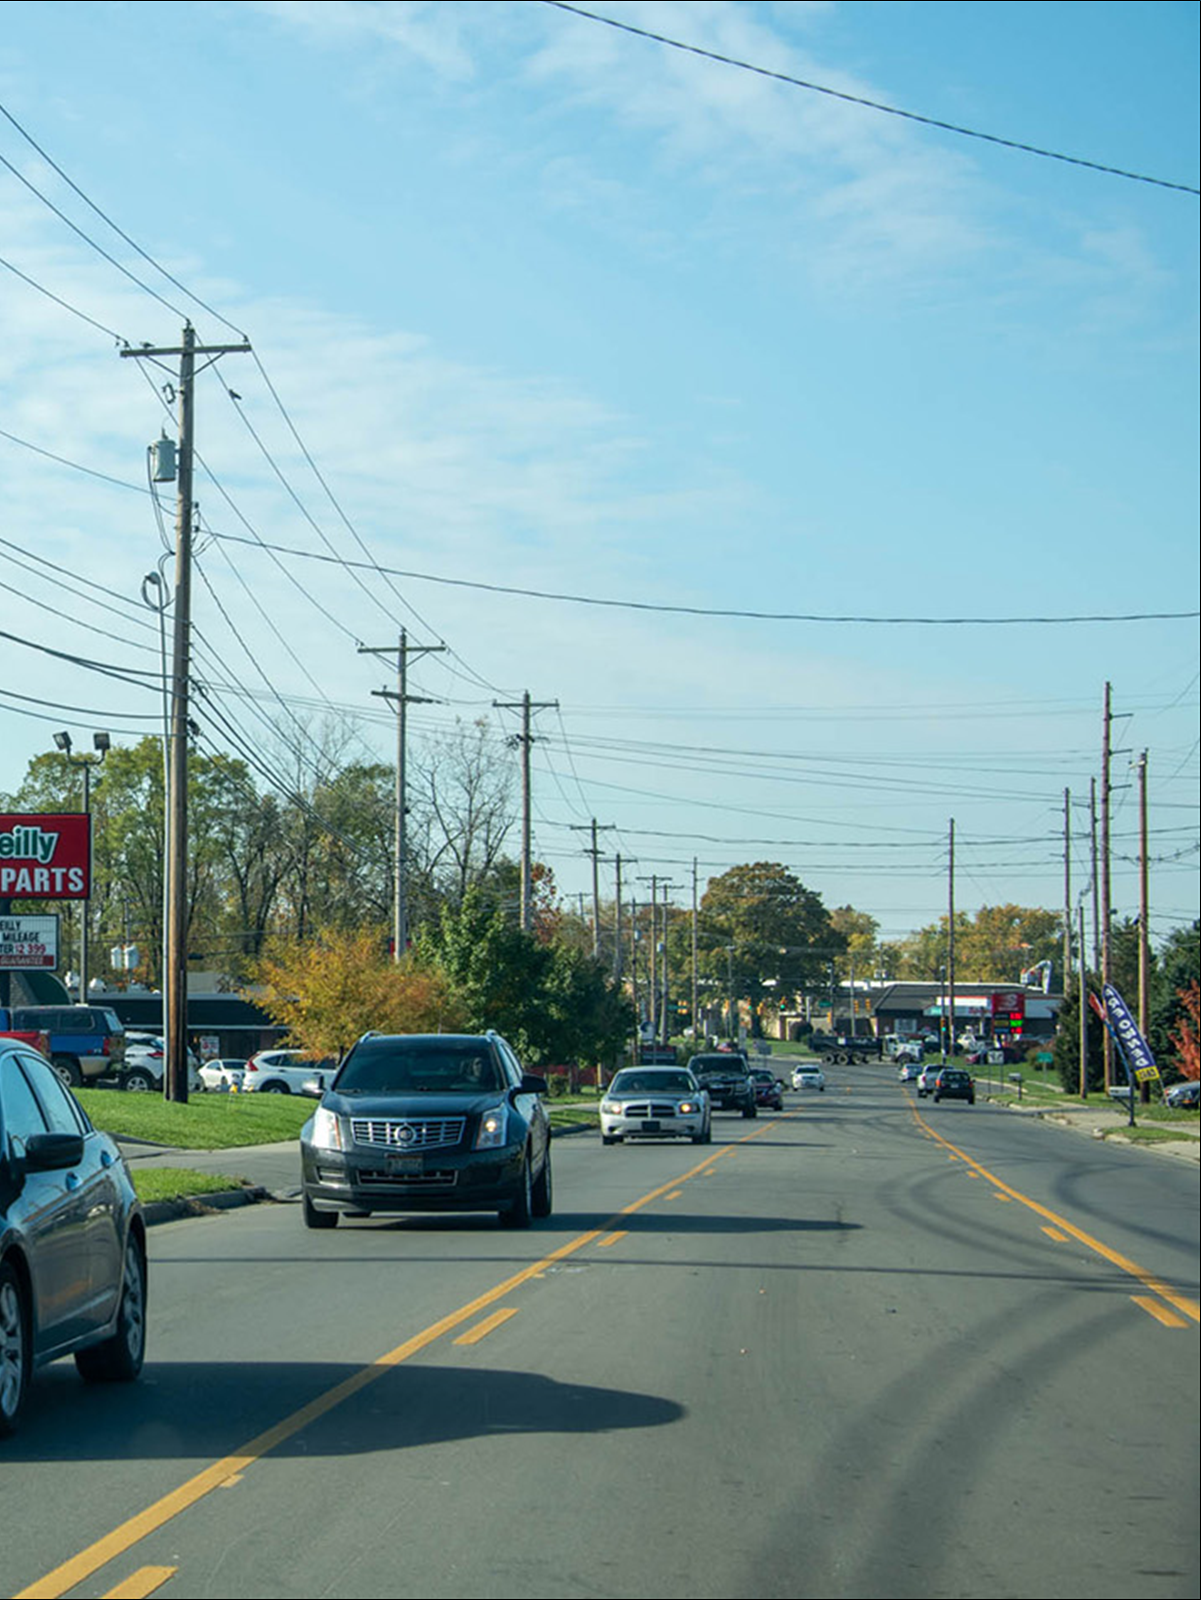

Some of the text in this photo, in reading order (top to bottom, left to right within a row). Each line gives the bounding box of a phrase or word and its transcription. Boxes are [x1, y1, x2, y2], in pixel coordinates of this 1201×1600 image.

[1, 867, 84, 893] PARTS
[2, 932, 40, 943] MILEAGE
[0, 955, 43, 965] GUARANTEE
